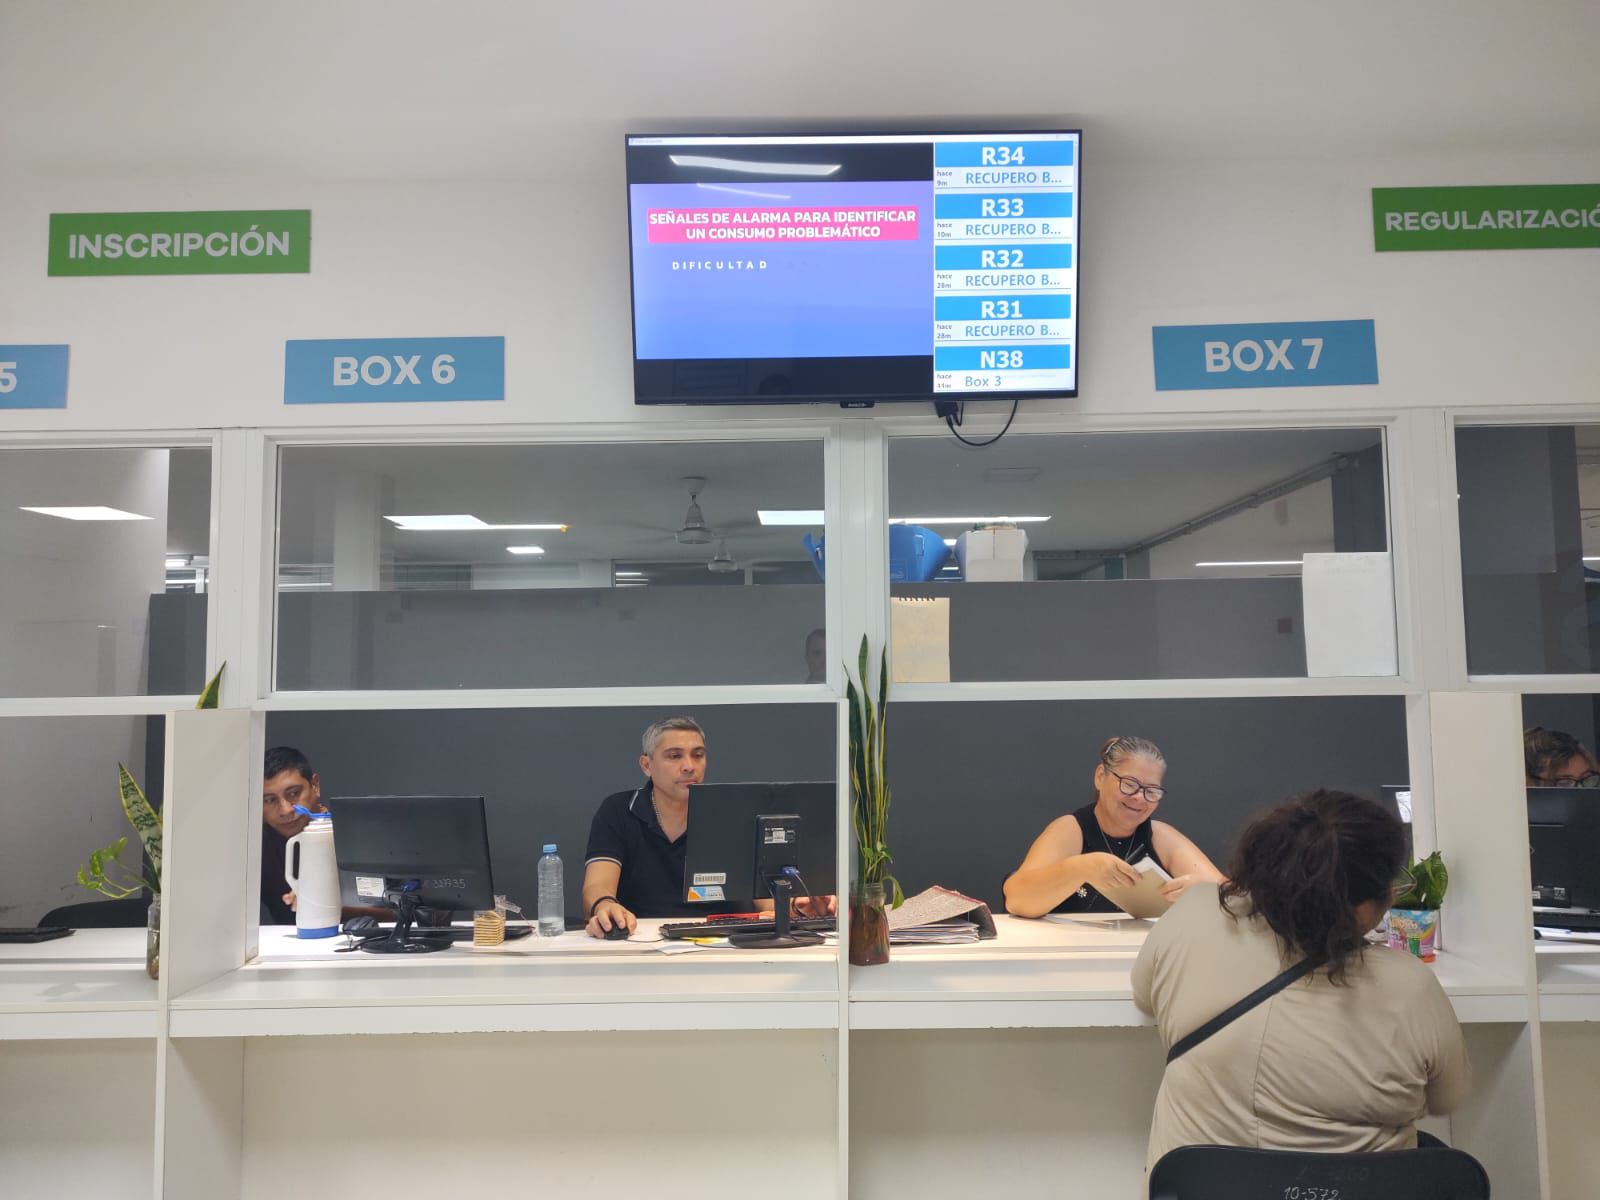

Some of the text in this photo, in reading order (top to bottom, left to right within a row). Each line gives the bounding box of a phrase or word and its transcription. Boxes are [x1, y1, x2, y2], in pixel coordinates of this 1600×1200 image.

[981, 146, 1025, 166] R34
[965, 171, 1037, 184] RECUPERO
[649, 209, 917, 225] SEÑALES DE ALARMA PARA IDENTIFICAR
[981, 198, 1025, 217] R33
[686, 222, 881, 240] UN CONSUMO PROBLEMÁTICO
[965, 223, 1036, 236] RECUPERO
[69, 224, 290, 259] INSCRIPCIÓN
[672, 260, 767, 271] DIFICULTAD
[981, 248, 1025, 269] R32
[965, 274, 1036, 287] RECUPERO
[981, 300, 1023, 319] R31
[965, 325, 1035, 337] RECUPERO
[980, 350, 1024, 369] N38
[1204, 338, 1324, 373] BOX 7
[0, 361, 17, 394] 5
[332, 354, 456, 386] BOX 6
[965, 375, 1002, 387] Box 3
